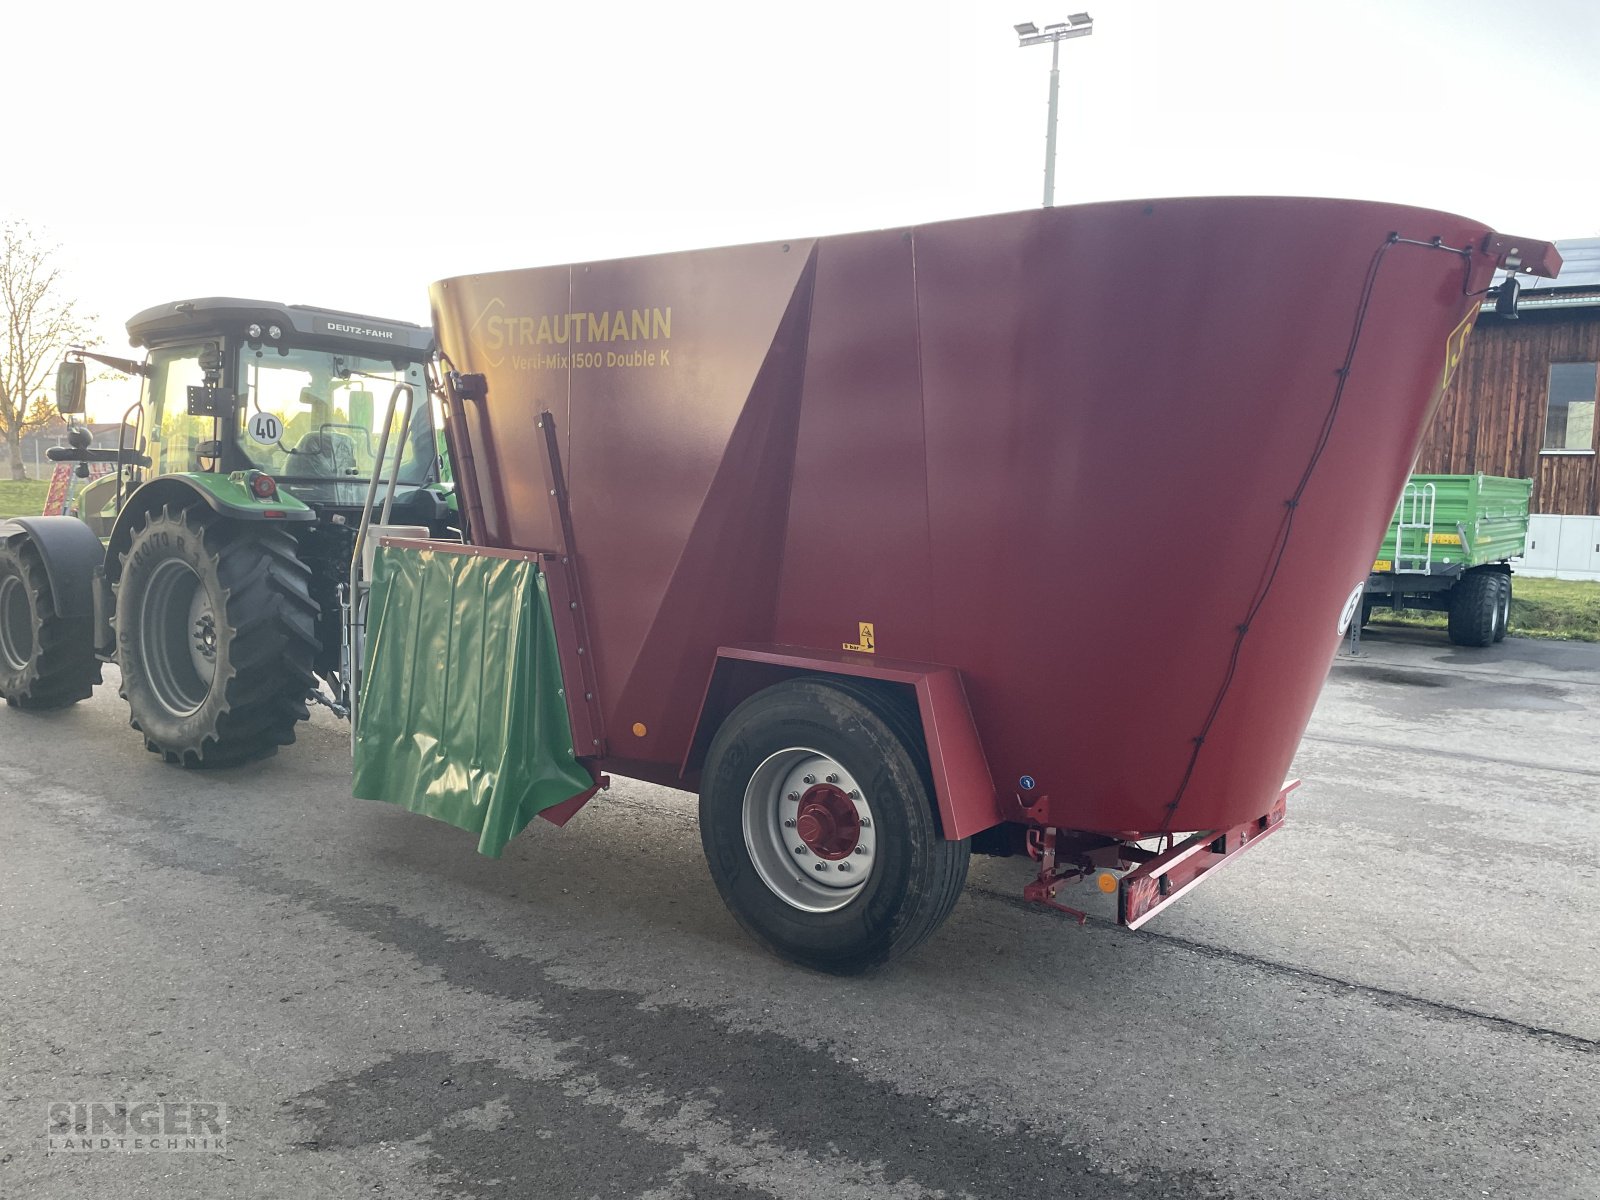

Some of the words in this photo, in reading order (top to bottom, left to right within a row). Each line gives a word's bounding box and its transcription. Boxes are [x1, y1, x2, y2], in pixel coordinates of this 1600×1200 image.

[327, 322, 393, 339] DEUTZ-FAHR
[487, 307, 671, 350] STRAUTMANN
[513, 353, 568, 370] Verti-Mix
[571, 353, 601, 369] 1500
[607, 350, 656, 368] Double
[660, 350, 670, 366] K
[255, 418, 277, 439] 40
